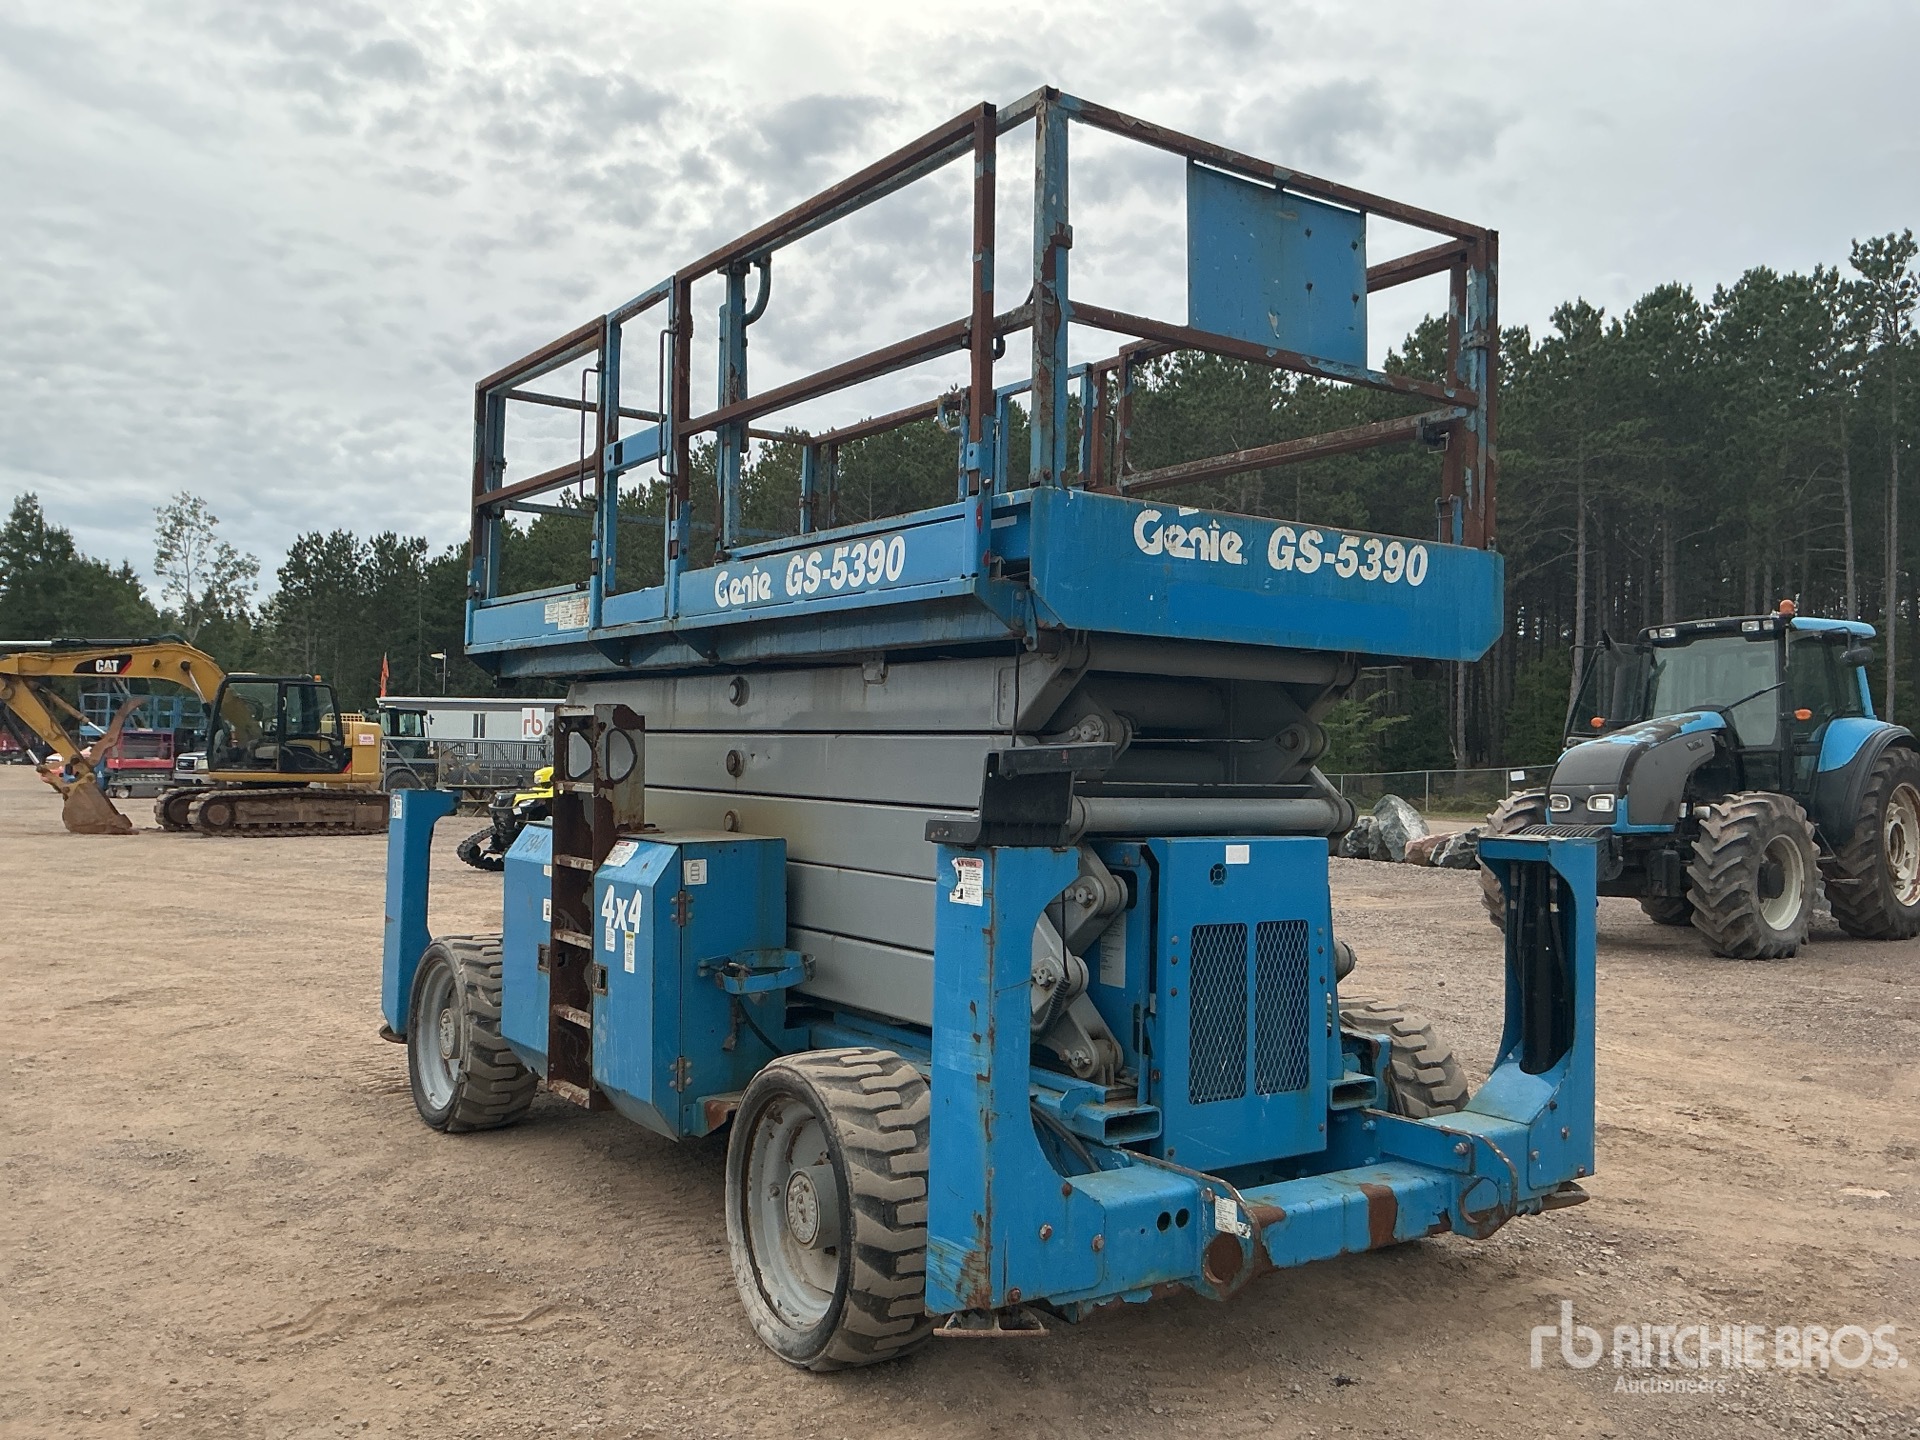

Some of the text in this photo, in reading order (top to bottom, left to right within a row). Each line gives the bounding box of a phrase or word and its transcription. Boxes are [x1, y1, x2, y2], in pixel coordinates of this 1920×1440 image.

[714, 535, 906, 608] Genie GS-5390
[1133, 509, 1429, 587] Genie GS-5390
[95, 659, 119, 673] CAT
[523, 709, 543, 736] rb
[601, 884, 642, 934] 4x4
